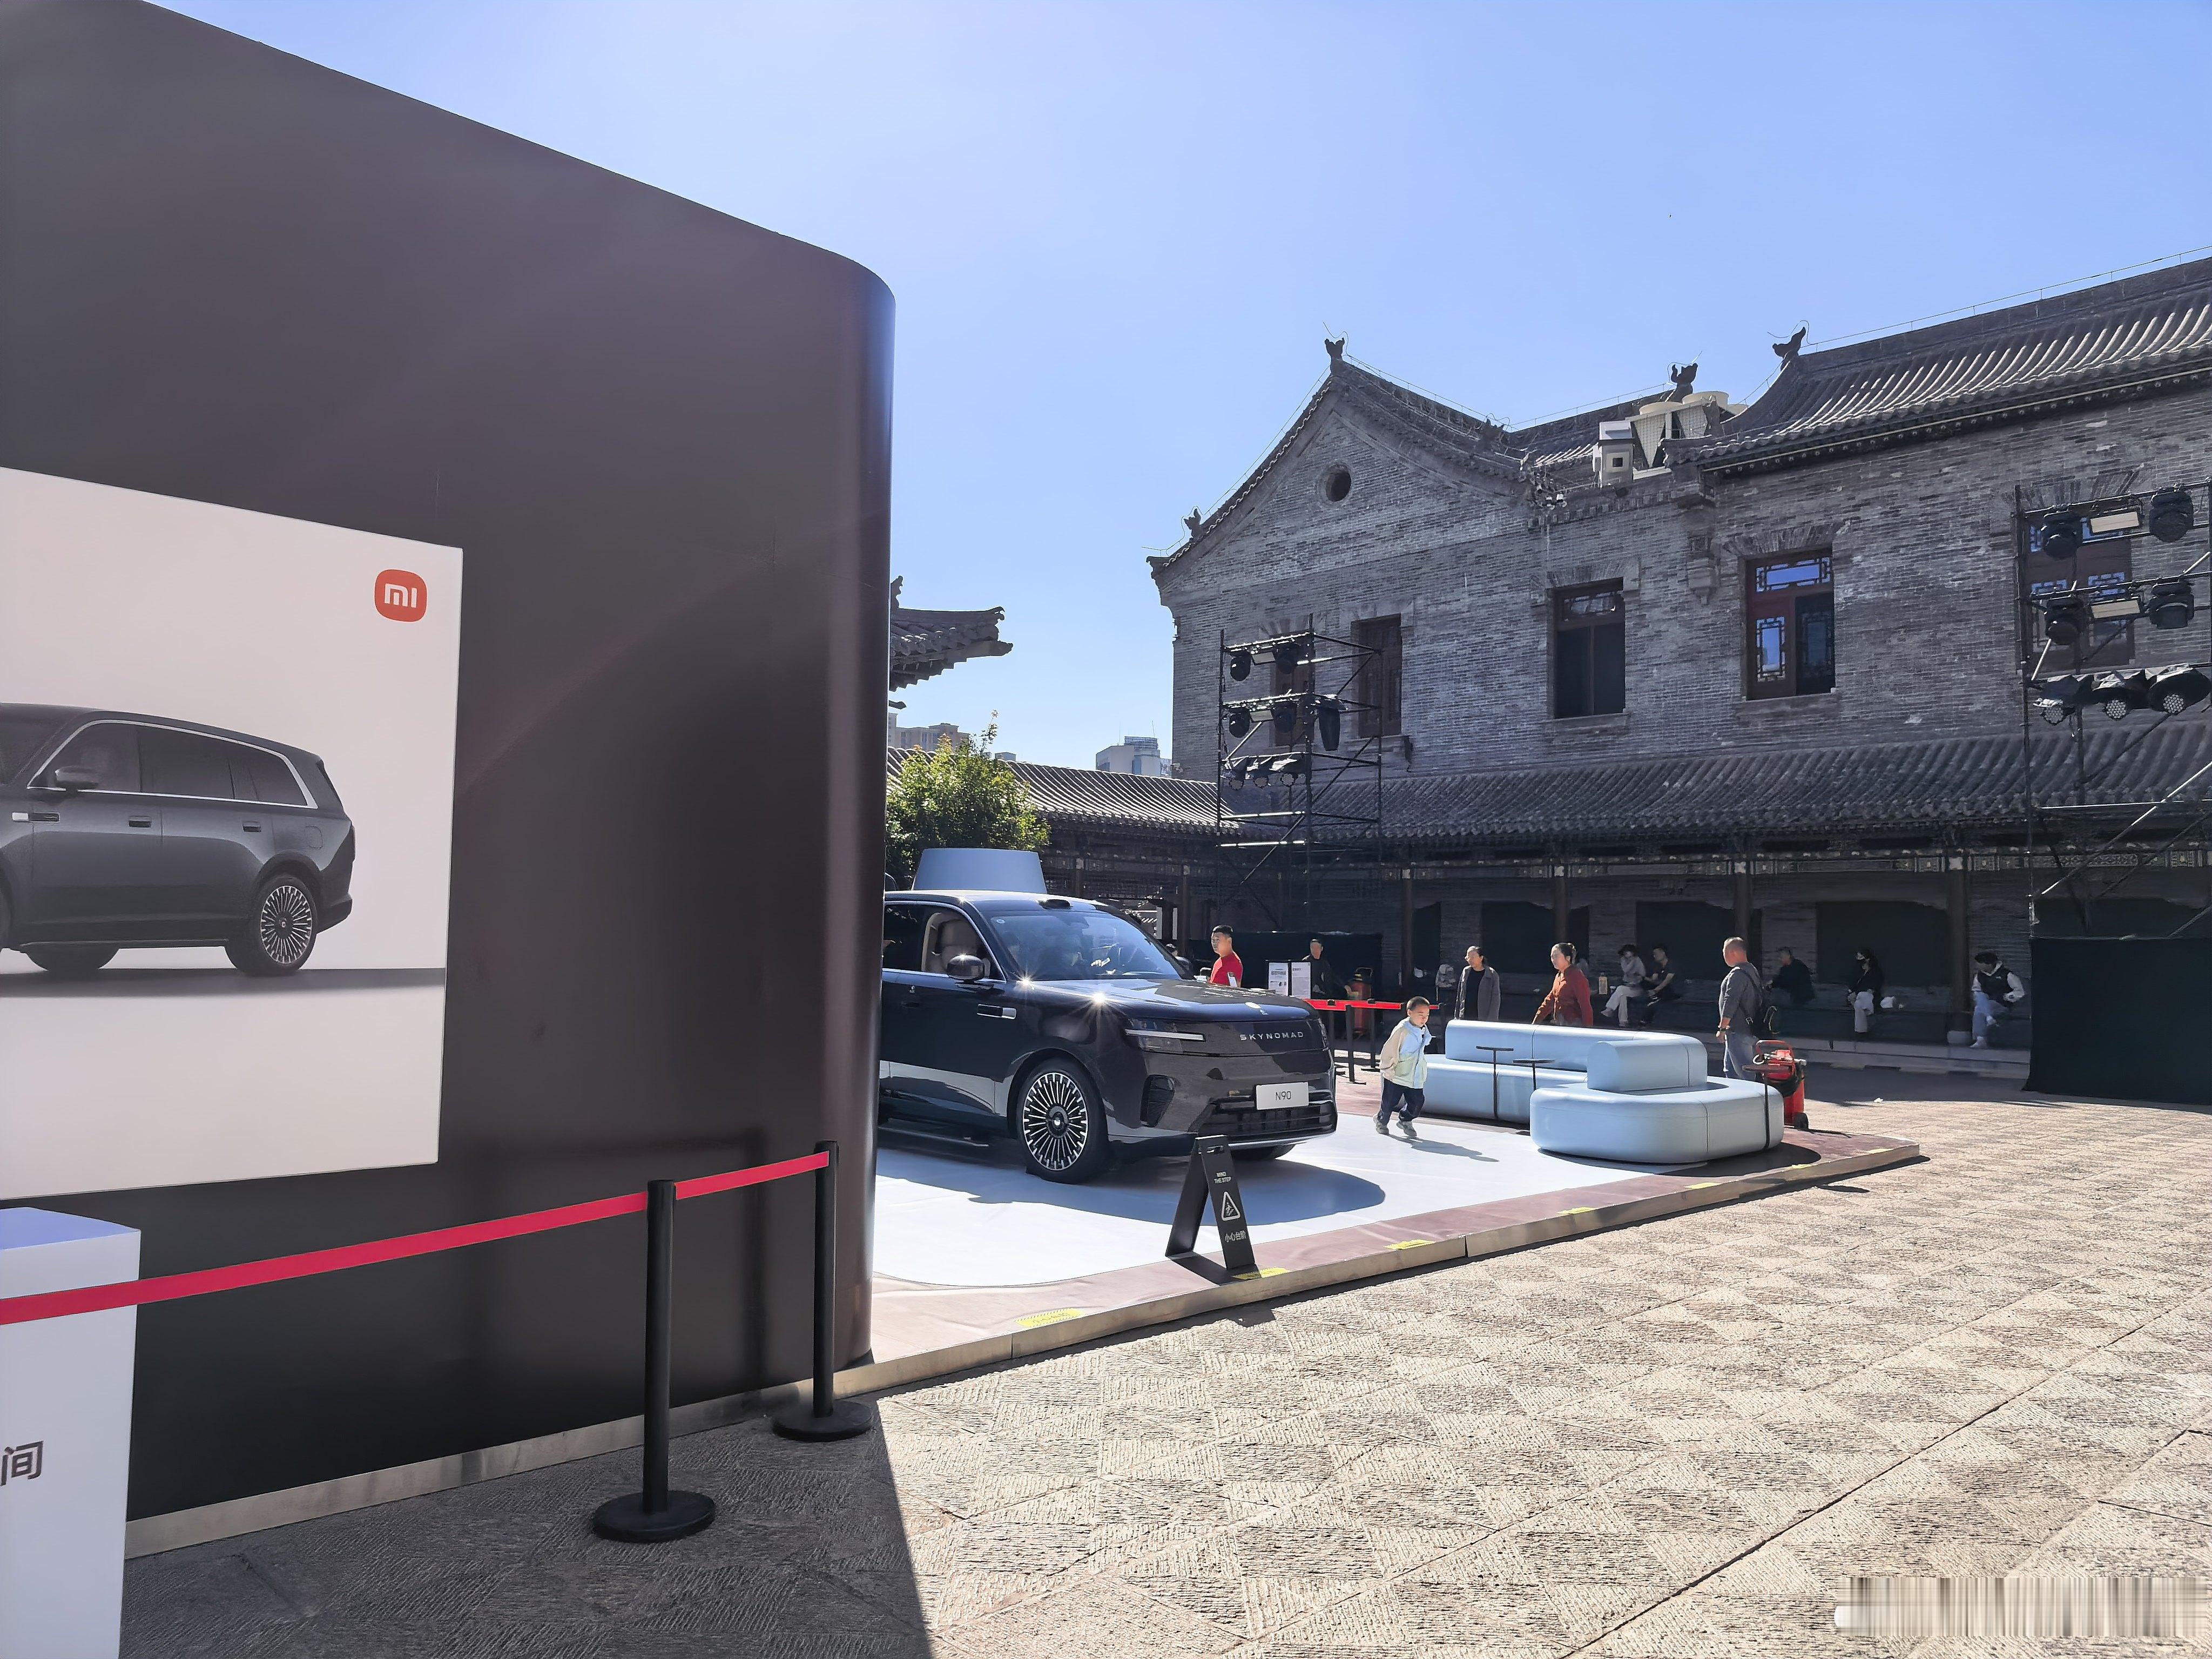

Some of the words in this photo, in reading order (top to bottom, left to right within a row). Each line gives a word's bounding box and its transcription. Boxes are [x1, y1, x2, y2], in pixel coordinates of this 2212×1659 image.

[1239, 1031, 1304, 1041] SKYNOMAD
[1275, 1091, 1292, 1101] N90
[1225, 1230, 1246, 1243] 小心台阶
[0, 1440, 43, 1487] 间
